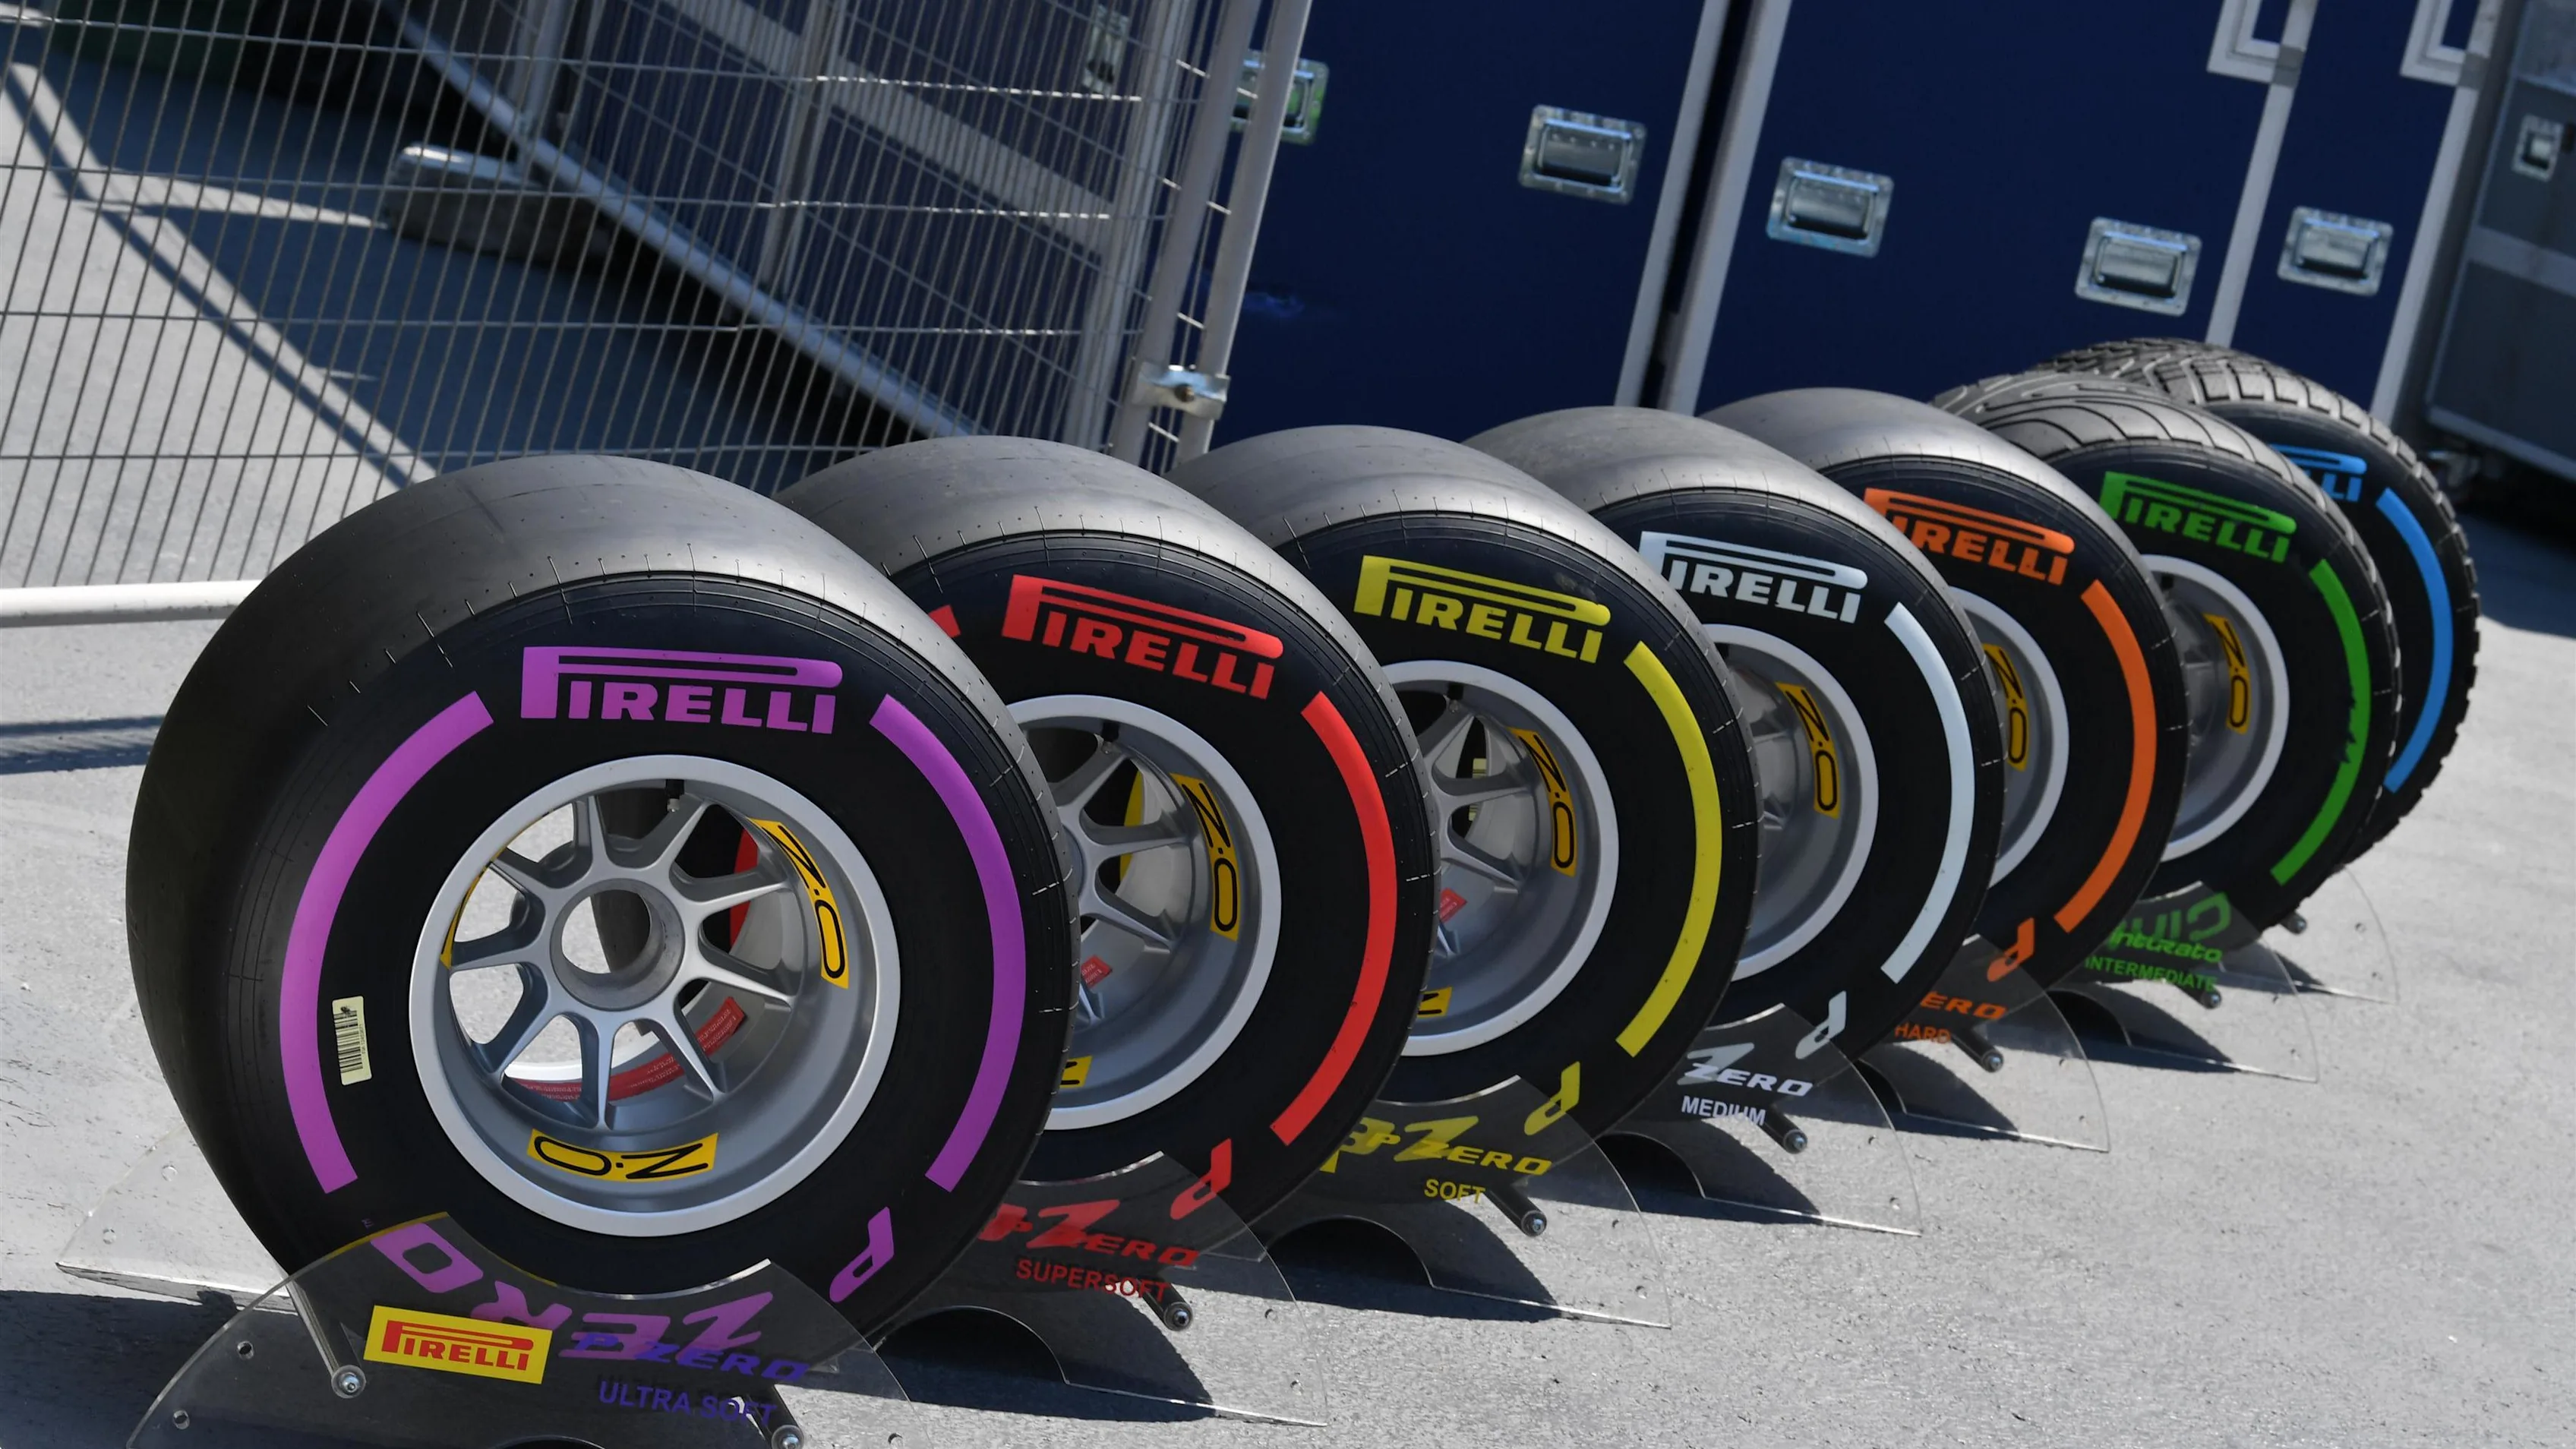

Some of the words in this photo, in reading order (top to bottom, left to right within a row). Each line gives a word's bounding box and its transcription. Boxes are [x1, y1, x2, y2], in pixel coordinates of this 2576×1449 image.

[2099, 471, 2297, 563] PIRELLI
[1638, 531, 1868, 623] PIRELLI
[1354, 555, 1611, 663] PIRELLI
[1002, 574, 1283, 699] PIRELLI
[521, 646, 843, 734] PIRELLI
[2084, 955, 2218, 993] INTERMEDIATE
[1920, 990, 2007, 1020] ERO
[1894, 1022, 1951, 1043] HARD
[1684, 1062, 1814, 1097] ZERO
[1681, 1095, 1766, 1126] MEDIUM
[1412, 1139, 1552, 1176] ZERO
[1424, 1178, 1486, 1204] SOFT
[1015, 1259, 1171, 1303] SUPERSOFT
[381, 1320, 534, 1371] PIRELLI
[633, 1341, 810, 1382] ZERO
[598, 1380, 691, 1415] ULTRA
[700, 1395, 778, 1426] SOFT
